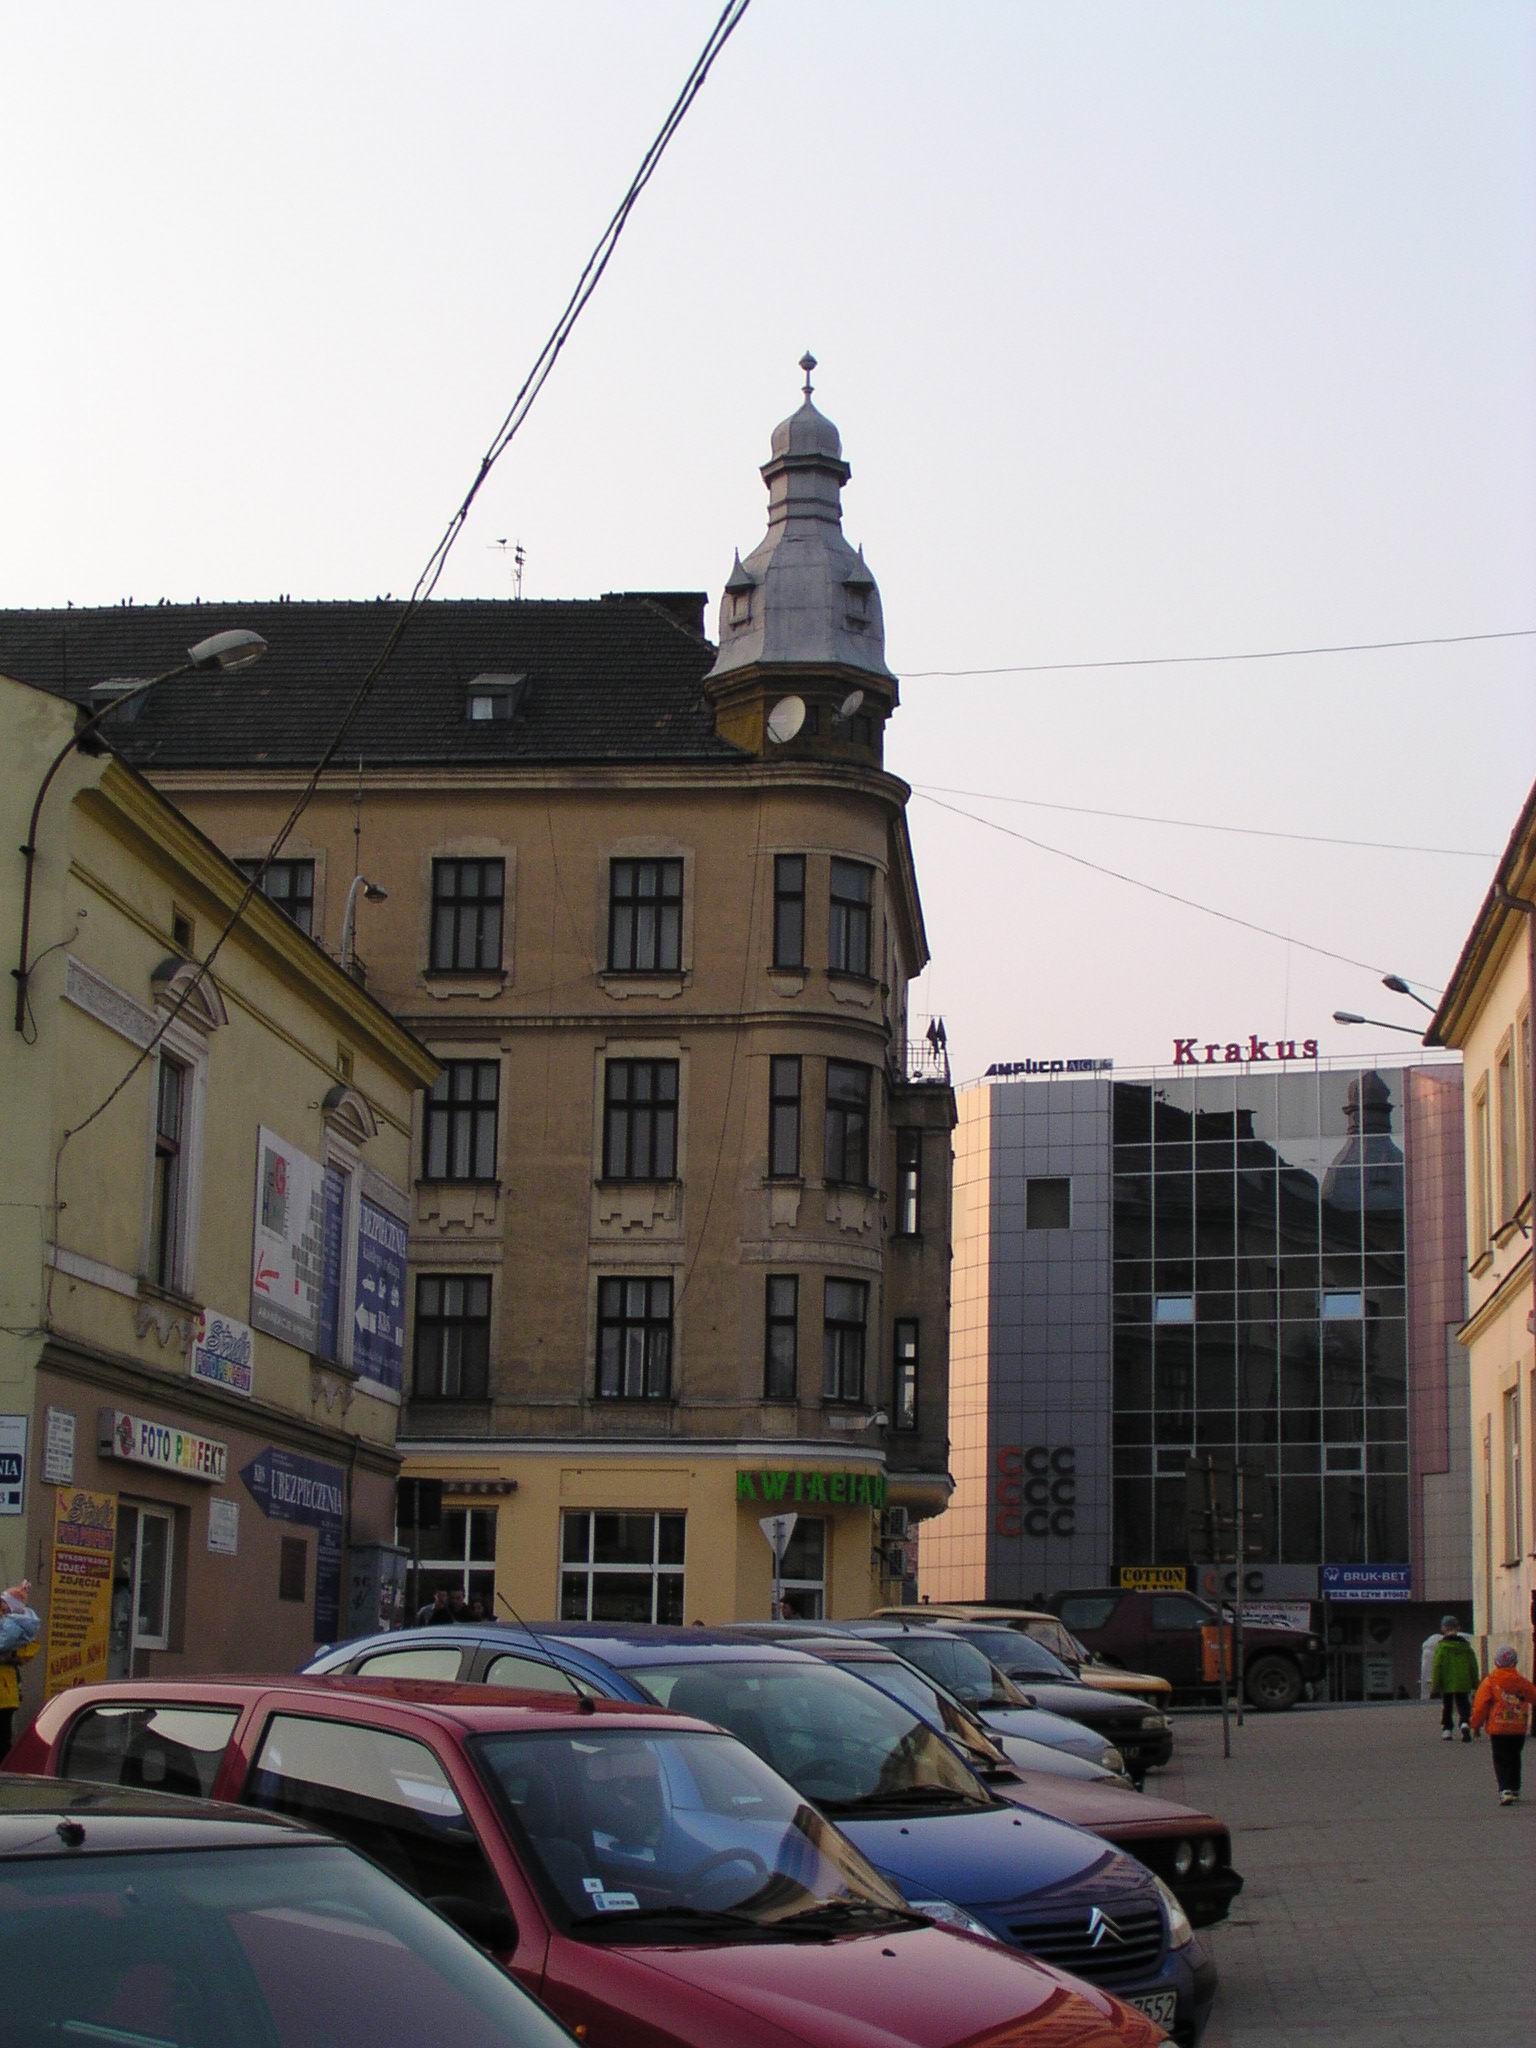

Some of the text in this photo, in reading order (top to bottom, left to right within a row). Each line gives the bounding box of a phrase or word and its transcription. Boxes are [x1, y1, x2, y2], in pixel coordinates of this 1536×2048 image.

[1173, 1034, 1318, 1065] Krakus
[141, 1423, 171, 1462] FOTO
[176, 1434, 224, 1474] PERFEKT
[996, 1446, 1075, 1474] CCC
[271, 1469, 342, 1516] UBEZPIECZENIA
[996, 1477, 1075, 1505] CCC
[996, 1507, 1075, 1536] CCC
[1122, 1568, 1183, 1582] COTTON
[1203, 1569, 1264, 1596] CCC
[1343, 1571, 1406, 1581] BRUK-BET
